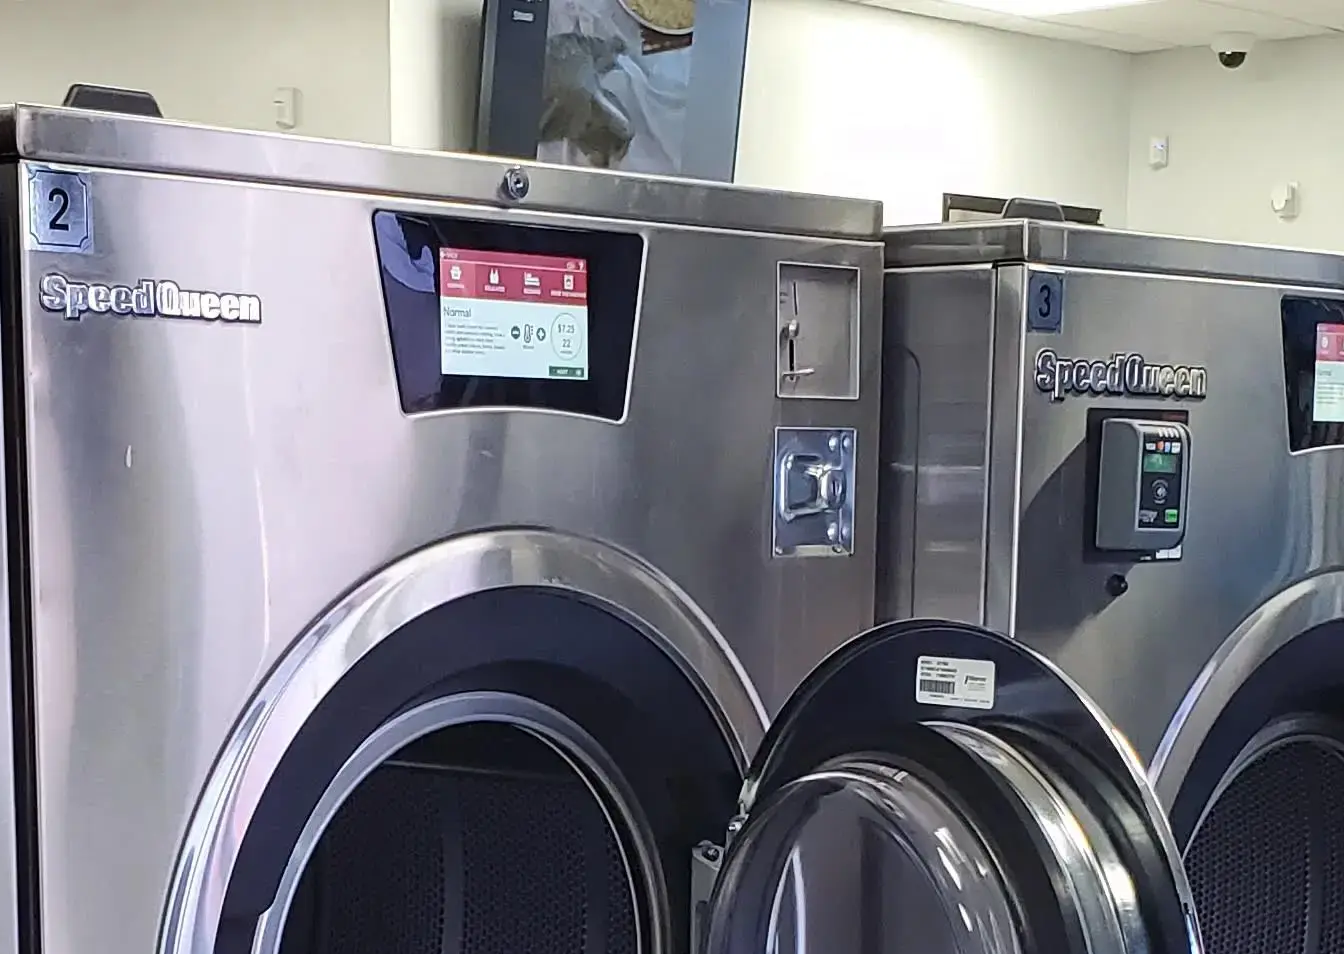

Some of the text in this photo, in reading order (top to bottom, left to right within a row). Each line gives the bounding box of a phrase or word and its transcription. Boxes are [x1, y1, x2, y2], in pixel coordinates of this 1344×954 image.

[48, 187, 70, 232] 2
[40, 271, 262, 324] Speed Queen
[443, 306, 472, 318] Normal
[1038, 284, 1051, 318] 3
[562, 338, 571, 348] 22
[1035, 348, 1207, 400] Speed Queen
